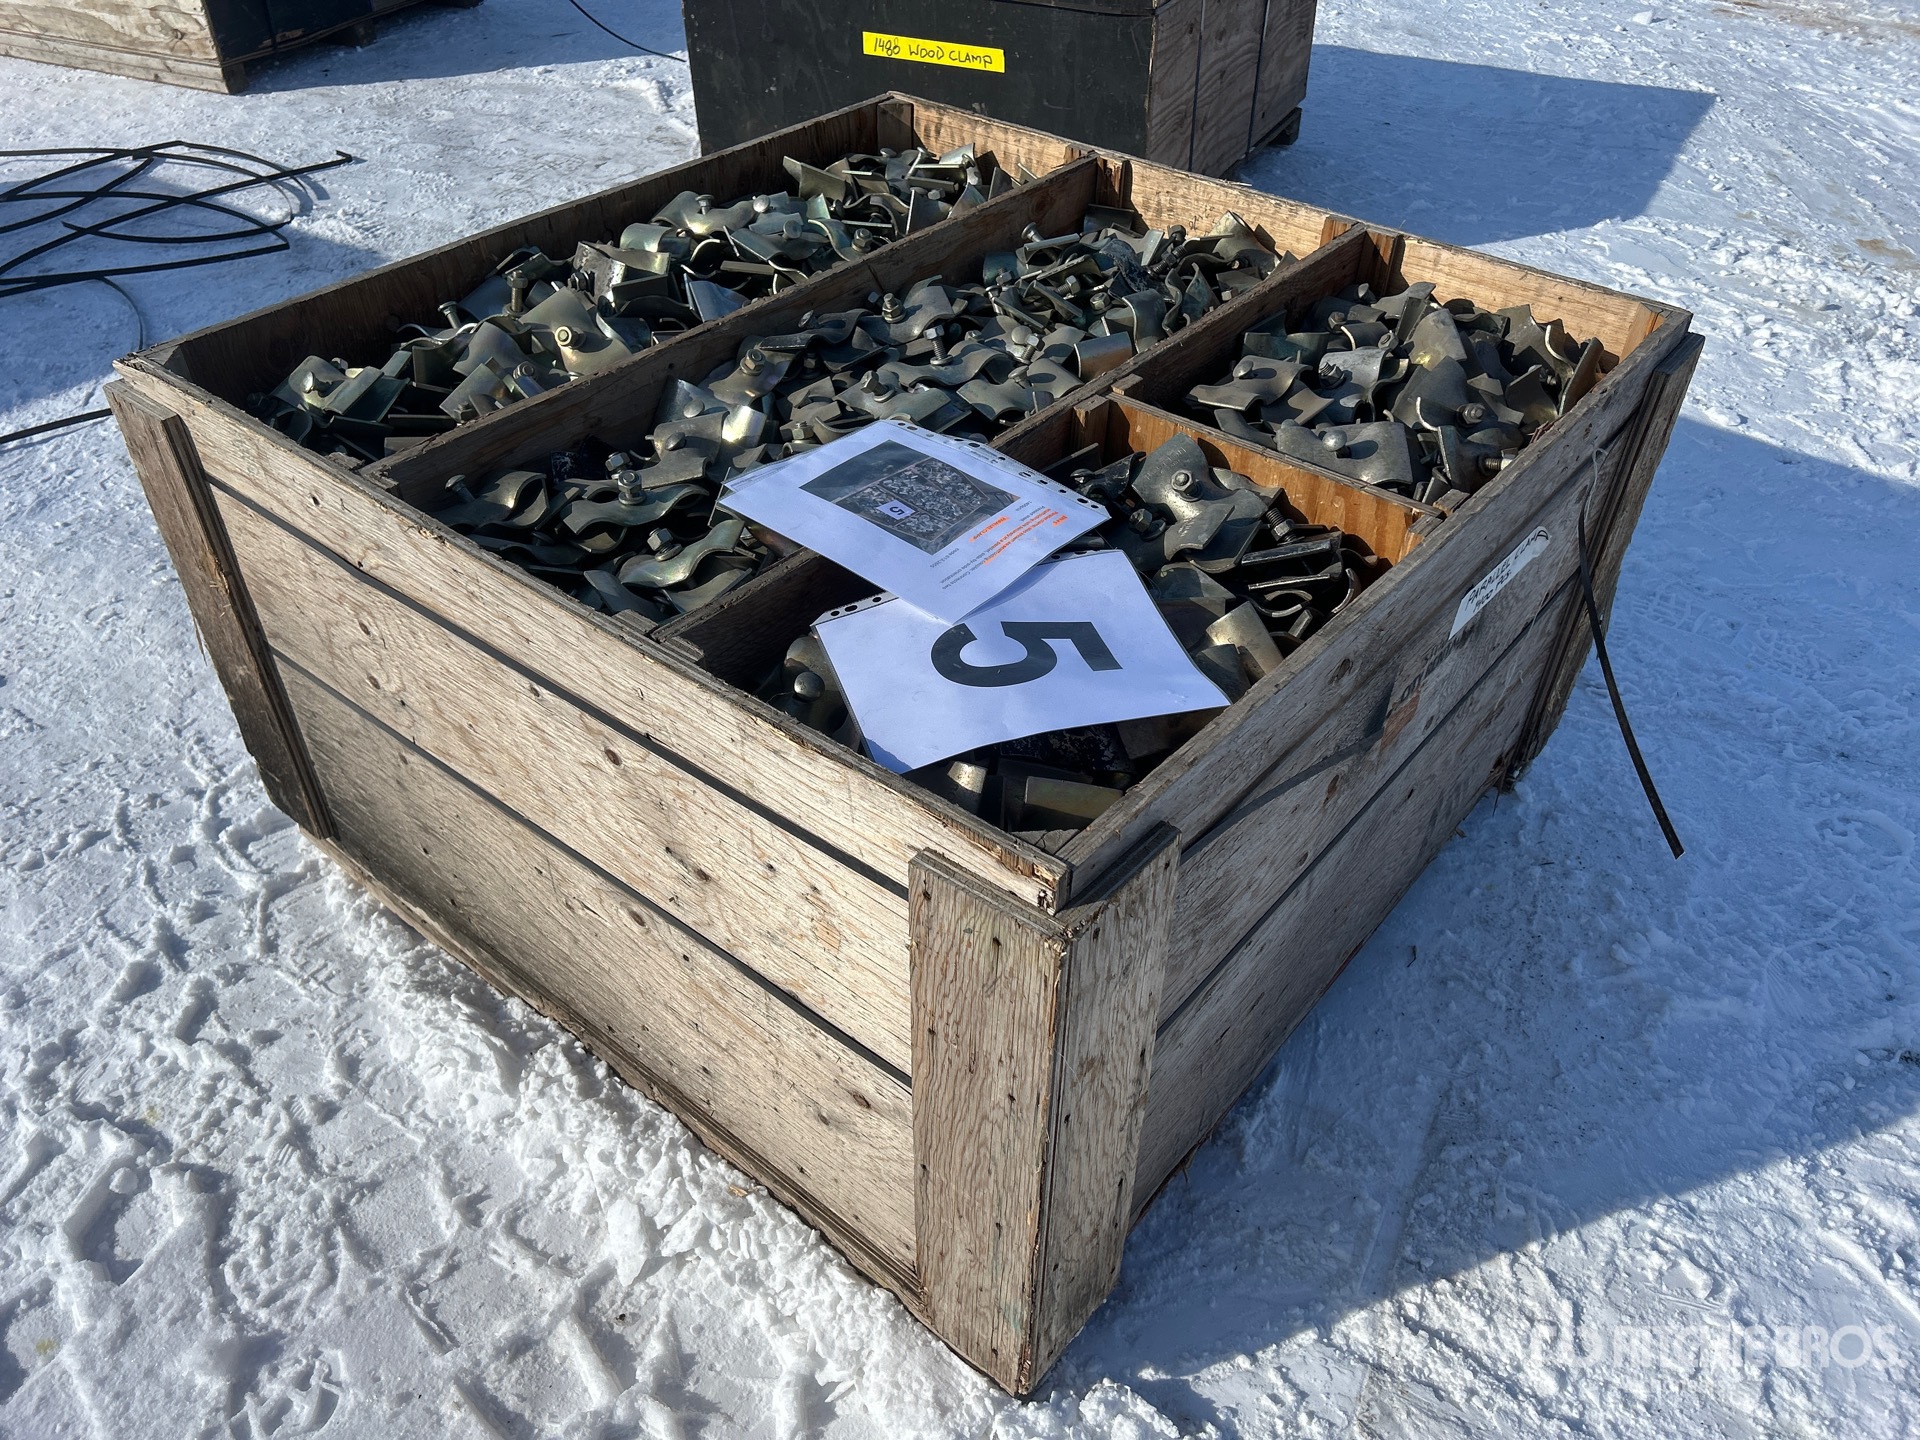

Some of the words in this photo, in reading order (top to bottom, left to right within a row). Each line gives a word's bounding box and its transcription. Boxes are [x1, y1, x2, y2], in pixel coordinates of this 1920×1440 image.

[908, 44, 945, 60] WOOD
[949, 51, 993, 68] CLAMP
[889, 506, 905, 516] 5
[1465, 559, 1511, 610] PARALLEL
[931, 621, 1123, 687] 5
